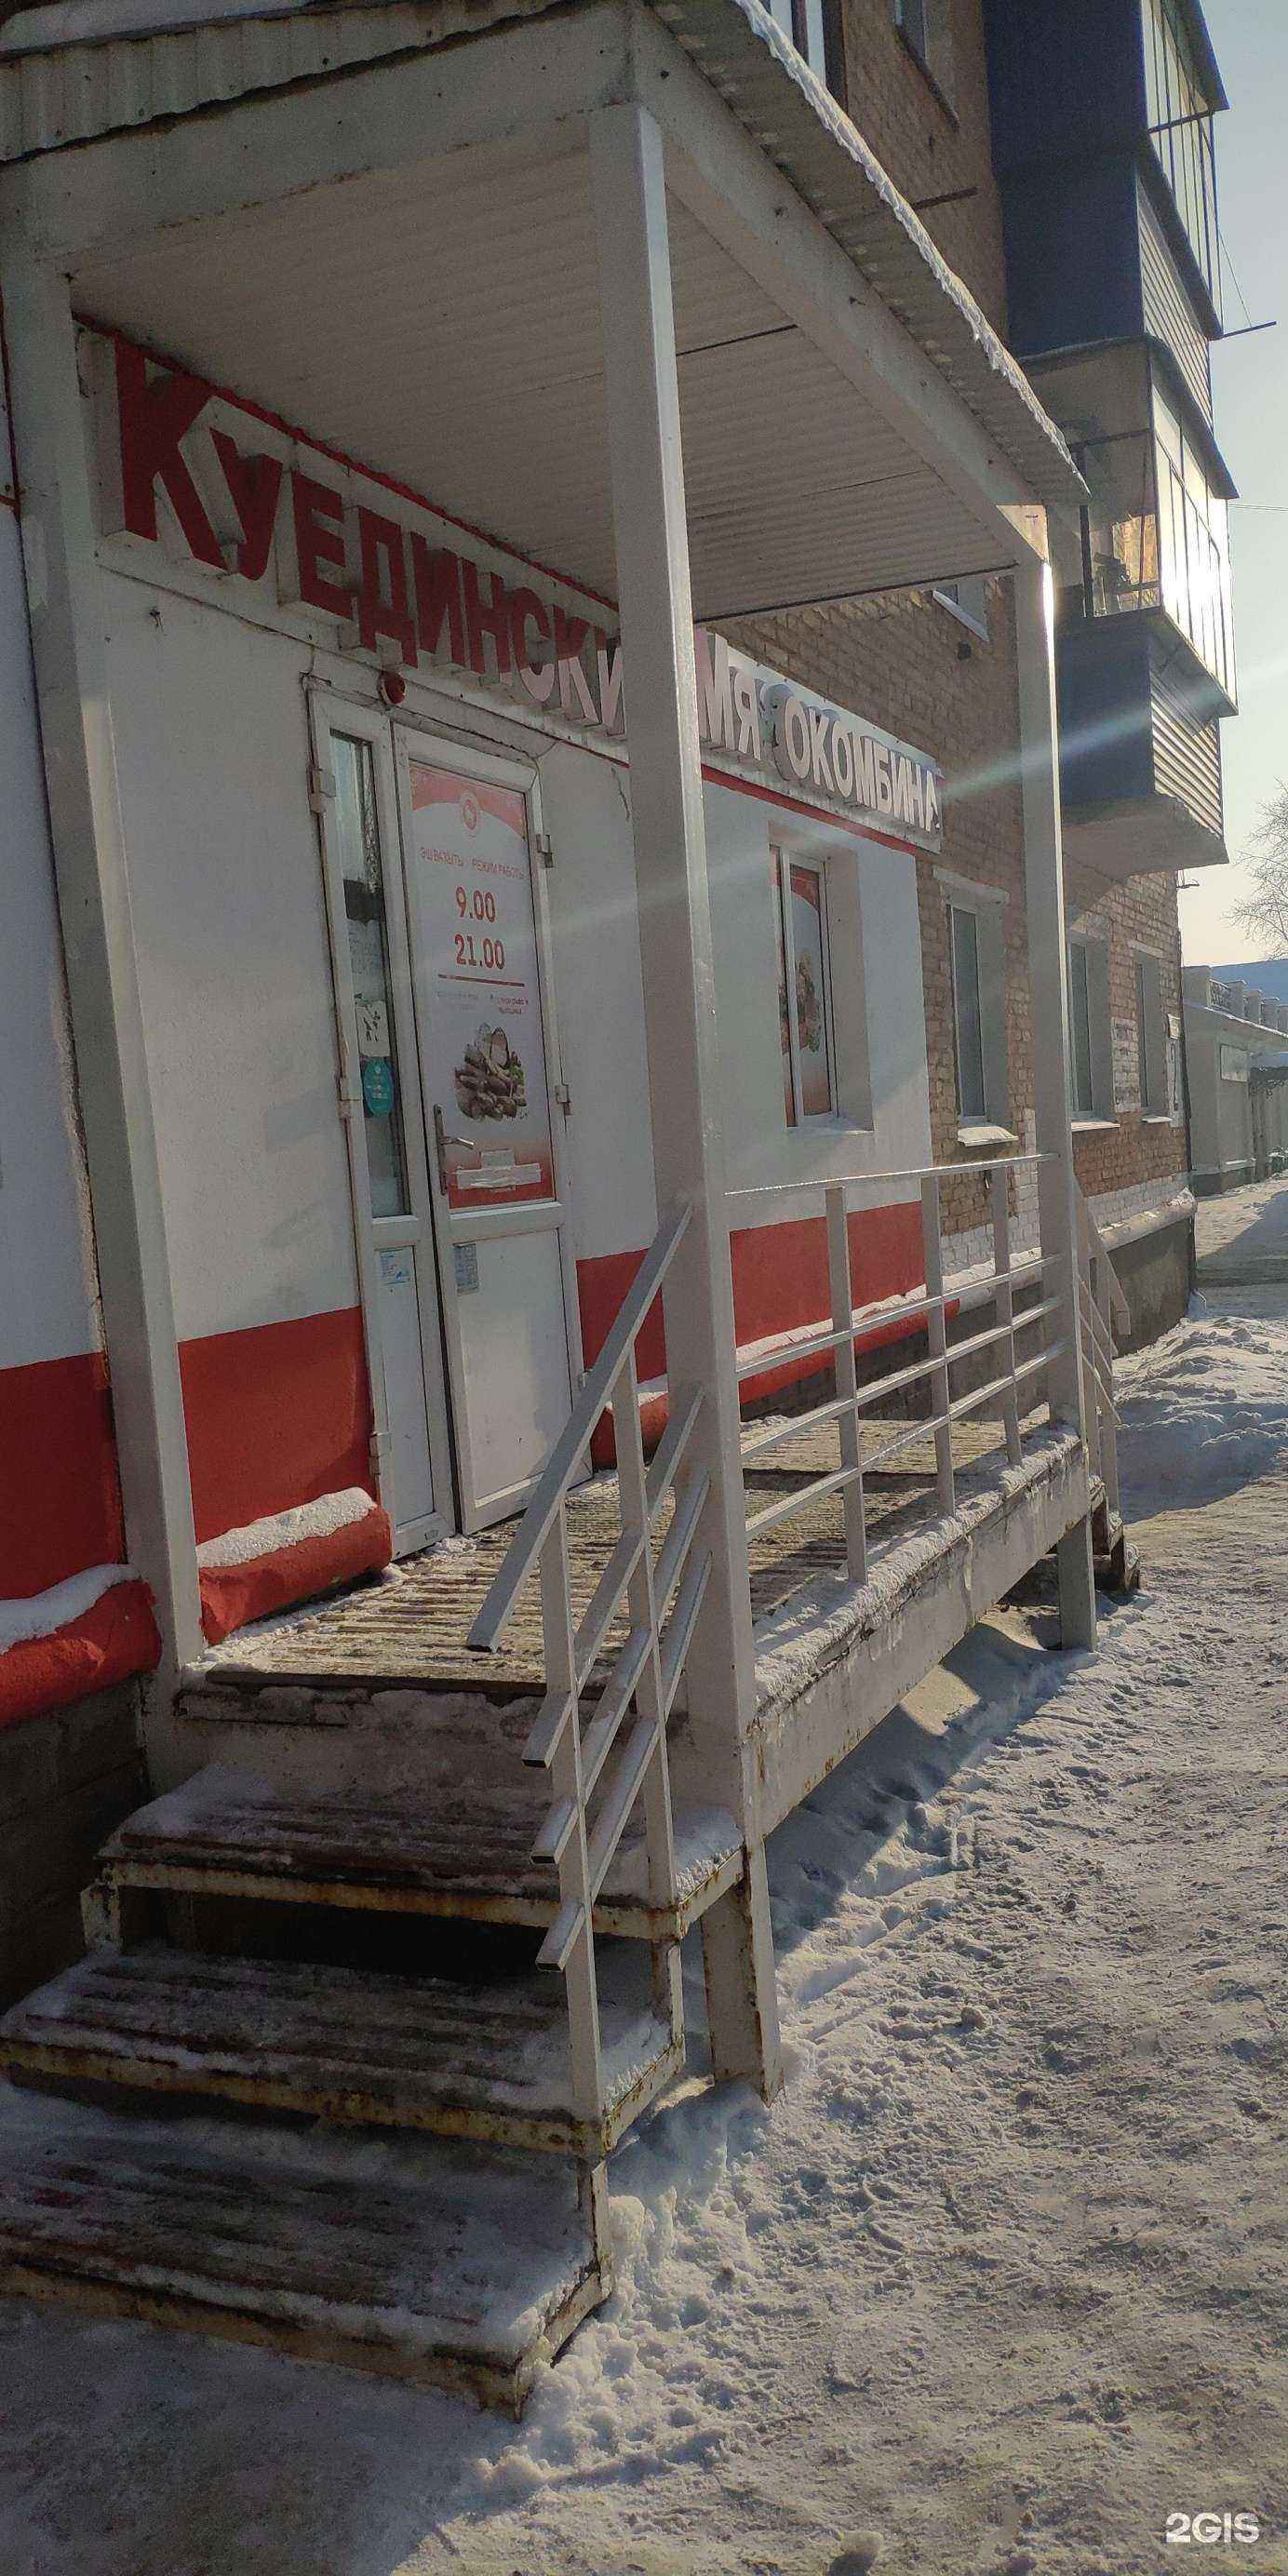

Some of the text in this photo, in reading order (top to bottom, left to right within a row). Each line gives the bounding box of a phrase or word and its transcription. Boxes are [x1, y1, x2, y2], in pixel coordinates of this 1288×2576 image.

[114, 332, 626, 726] КУЕДИНСКИ
[456, 886, 496, 922] 9.00
[454, 933, 505, 970] 21.00
